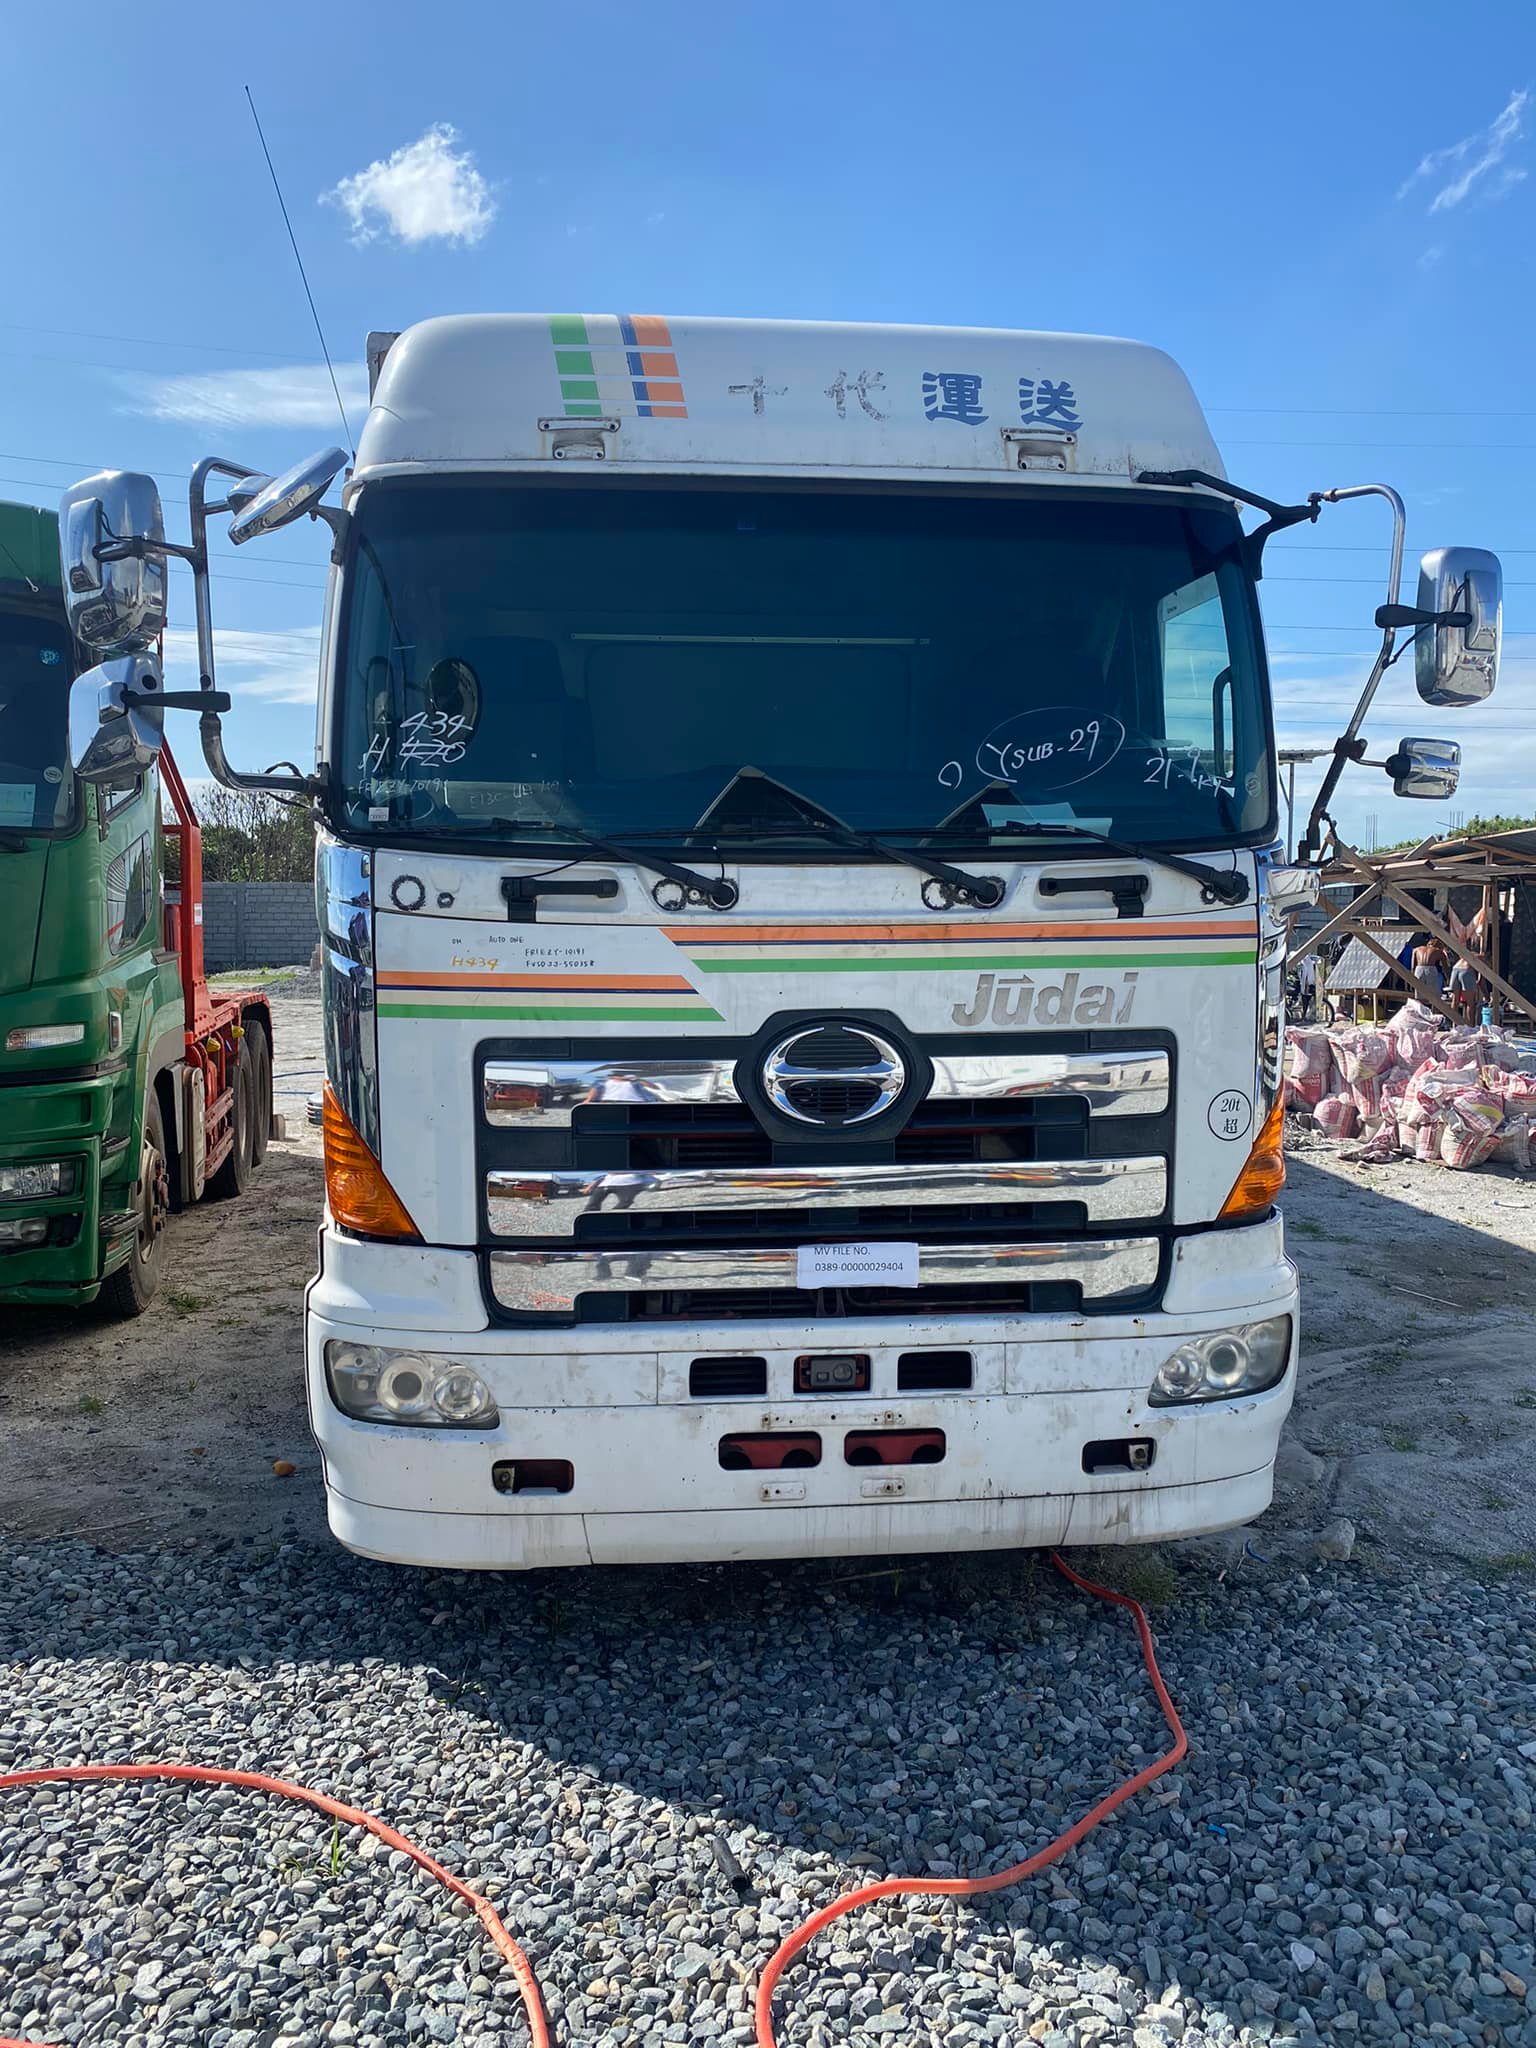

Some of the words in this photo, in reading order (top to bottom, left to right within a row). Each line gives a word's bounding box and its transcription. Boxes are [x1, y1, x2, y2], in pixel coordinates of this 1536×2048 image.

[399, 711, 473, 738] 434
[985, 720, 1100, 778] YSUB-29
[451, 954, 499, 971] H434
[814, 1247, 831, 1256] MV
[832, 1246, 851, 1255] FILE
[853, 1246, 871, 1255] NO.
